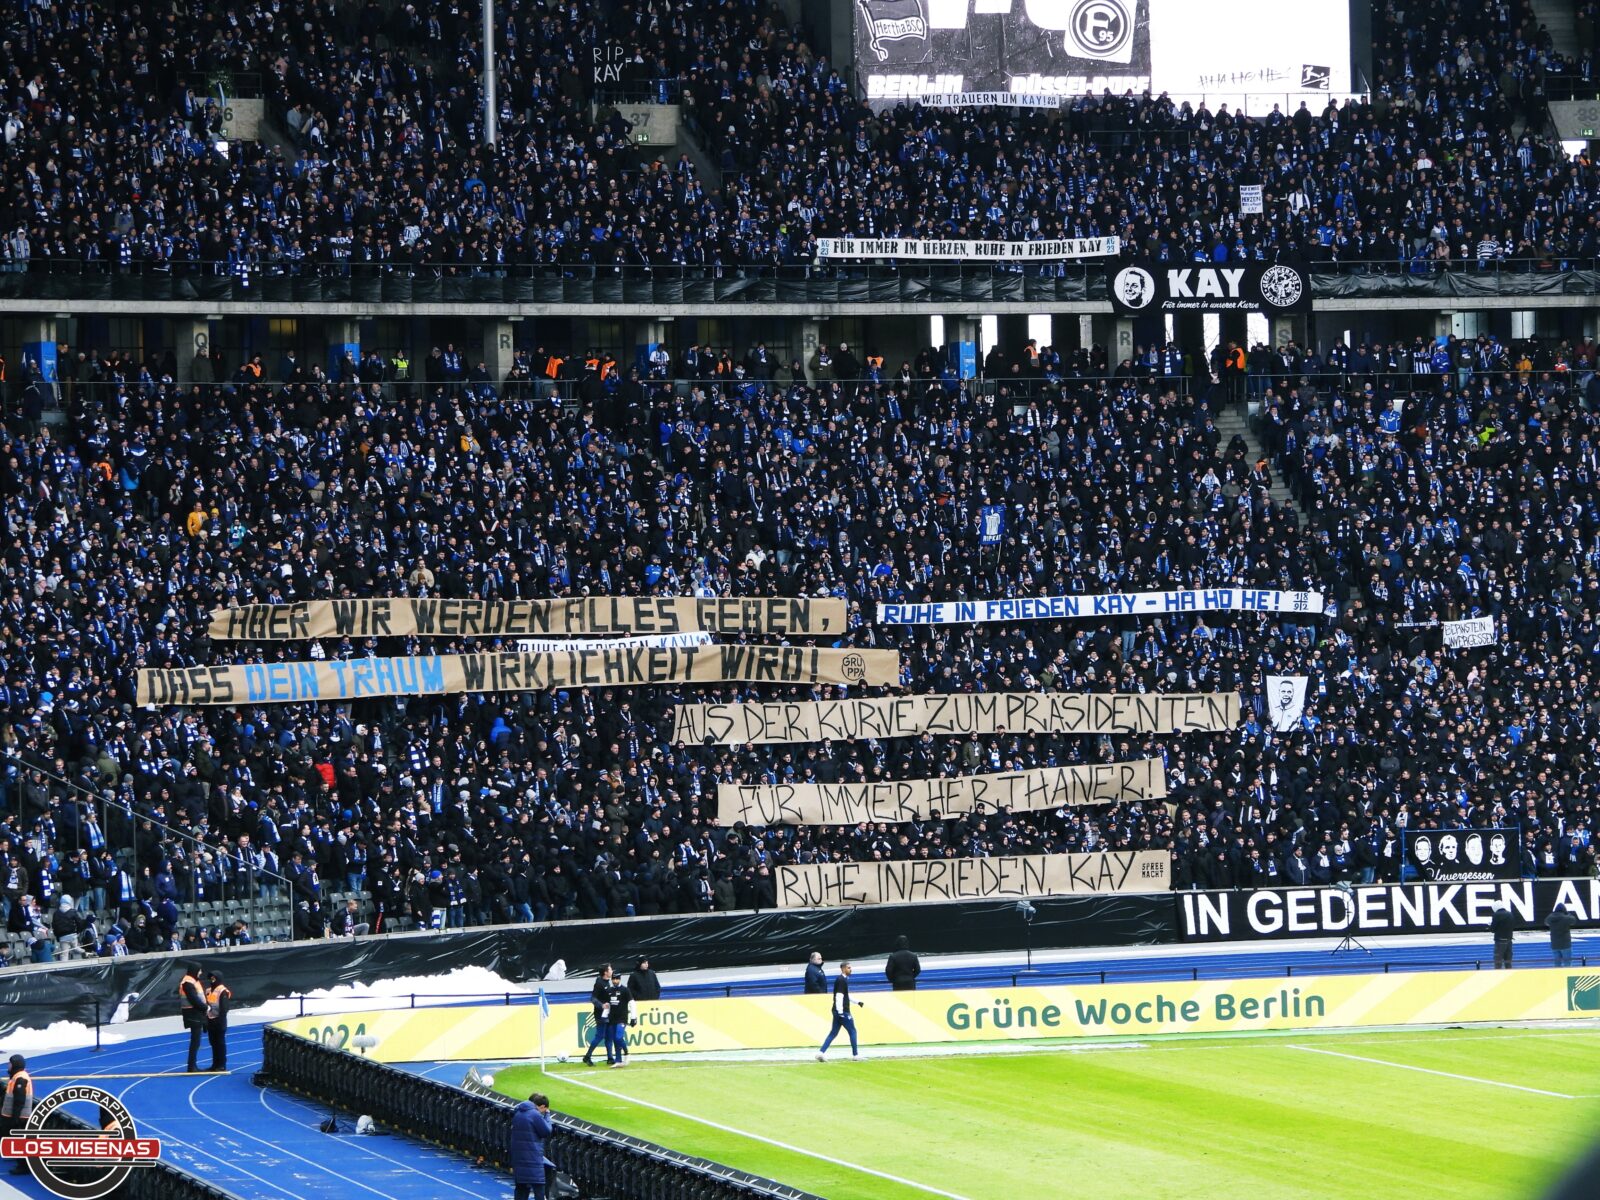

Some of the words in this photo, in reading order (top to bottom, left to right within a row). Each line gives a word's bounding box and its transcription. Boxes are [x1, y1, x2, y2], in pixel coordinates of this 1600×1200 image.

[1099, 31, 1114, 42] 95
[593, 46, 623, 63] RIP
[594, 63, 623, 83] KAY
[921, 95, 942, 105] WIR
[946, 94, 998, 105] TRAUERN
[1002, 94, 1018, 104] UM
[1022, 94, 1046, 106] KAY!
[630, 112, 650, 127] 37
[833, 239, 855, 254] FÜR
[860, 241, 898, 254] IMMER
[904, 242, 918, 254] IM
[923, 242, 969, 257] HERZEN,
[975, 243, 1006, 256] RUHE
[1011, 243, 1023, 256] IN
[1028, 241, 1074, 256] FRIEDEN
[1080, 239, 1101, 253] KAY
[1107, 245, 1115, 253] 23
[1167, 268, 1246, 298] KAY
[1161, 300, 1176, 309] Für
[1201, 301, 1208, 309] in
[1237, 301, 1260, 309] Kurve
[194, 332, 207, 350] Q
[499, 334, 511, 349] R
[1120, 331, 1131, 346] R
[884, 603, 944, 624] RUHE
[955, 602, 976, 621] IN
[986, 596, 1080, 620] FRIEDEN
[1093, 594, 1137, 615] KAY
[1164, 591, 1197, 611] HA
[1204, 589, 1233, 609] HO
[1241, 591, 1280, 611] HE!
[227, 602, 310, 639] ABER
[332, 599, 392, 636] WIR
[411, 598, 550, 636] WERDEN
[564, 598, 679, 633] ALLES
[697, 597, 829, 633] GEBEN,
[843, 656, 863, 667] GRU
[147, 666, 234, 705] DASS
[245, 662, 320, 702] DEIN
[329, 655, 446, 698] TRAUM
[459, 647, 700, 690] WIRKLICHKEIT
[720, 645, 818, 683] WIRD!
[847, 667, 866, 677] PPA
[677, 705, 735, 742] AUS
[743, 703, 809, 741] DER
[816, 698, 918, 739] KURVE
[924, 695, 997, 733] ZUM
[1006, 694, 1230, 733] PRÄSIDENTEN
[738, 784, 803, 825] FÜR
[816, 783, 920, 823] IMMER
[1142, 862, 1165, 870] SPREE
[1142, 870, 1165, 878] MACHT
[1426, 867, 1495, 881] Unvergessen
[781, 864, 867, 905] RUHE
[1068, 851, 1136, 892] KAY
[1183, 892, 1231, 936] IN
[1246, 880, 1536, 935] GEDENKEN
[638, 1007, 689, 1026] rüne
[946, 998, 1061, 1031] Grüne
[1074, 994, 1201, 1026] Woche
[1215, 987, 1326, 1022] Berlin
